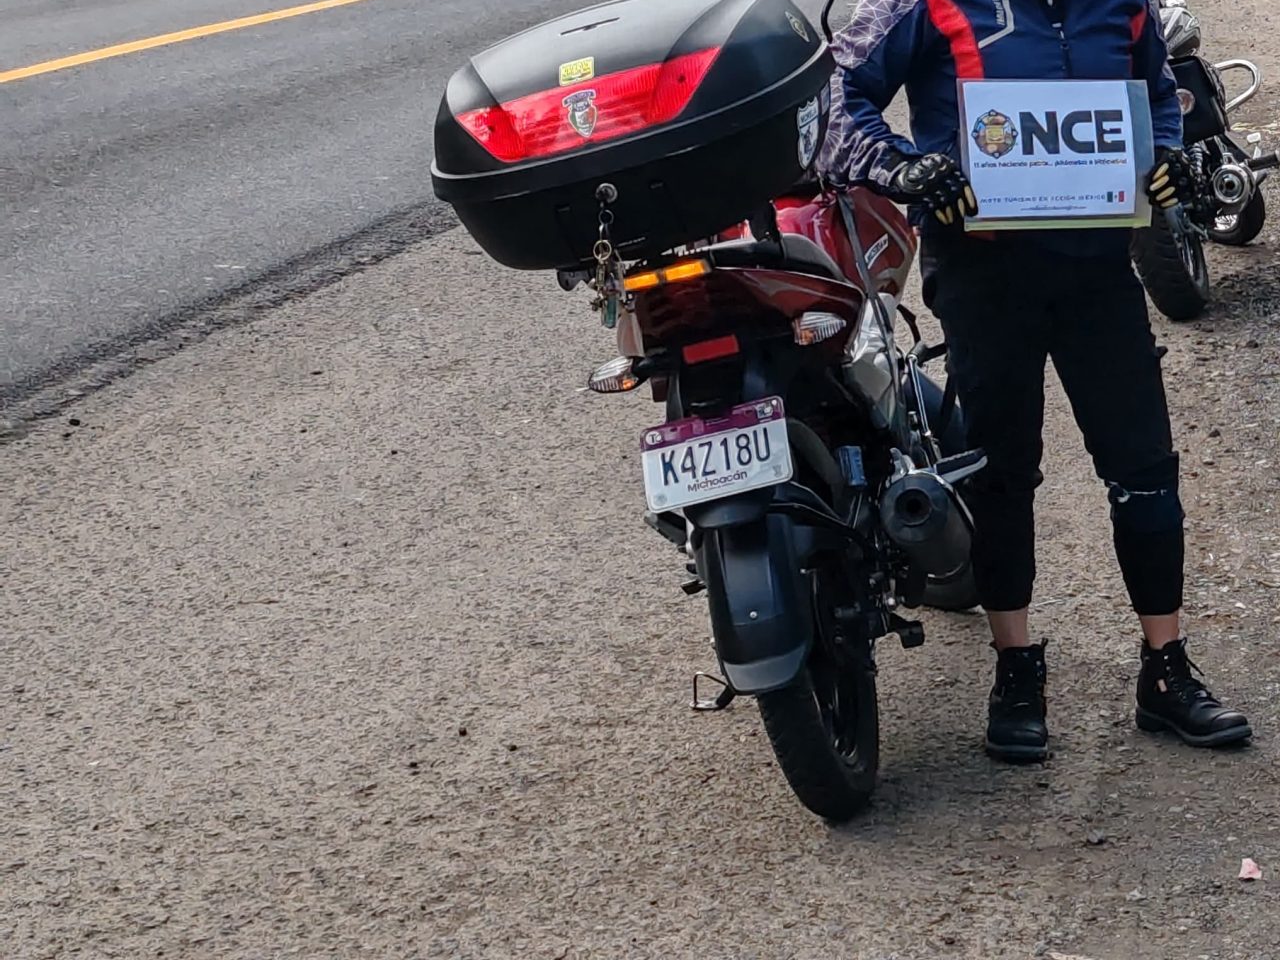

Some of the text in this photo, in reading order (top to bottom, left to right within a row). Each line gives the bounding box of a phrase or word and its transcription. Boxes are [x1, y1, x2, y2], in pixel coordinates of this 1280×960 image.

[981, 160, 997, 168] años
[998, 160, 1028, 168] haciendo
[660, 427, 771, 486] K4Z18U
[687, 470, 748, 493] Michoacán
